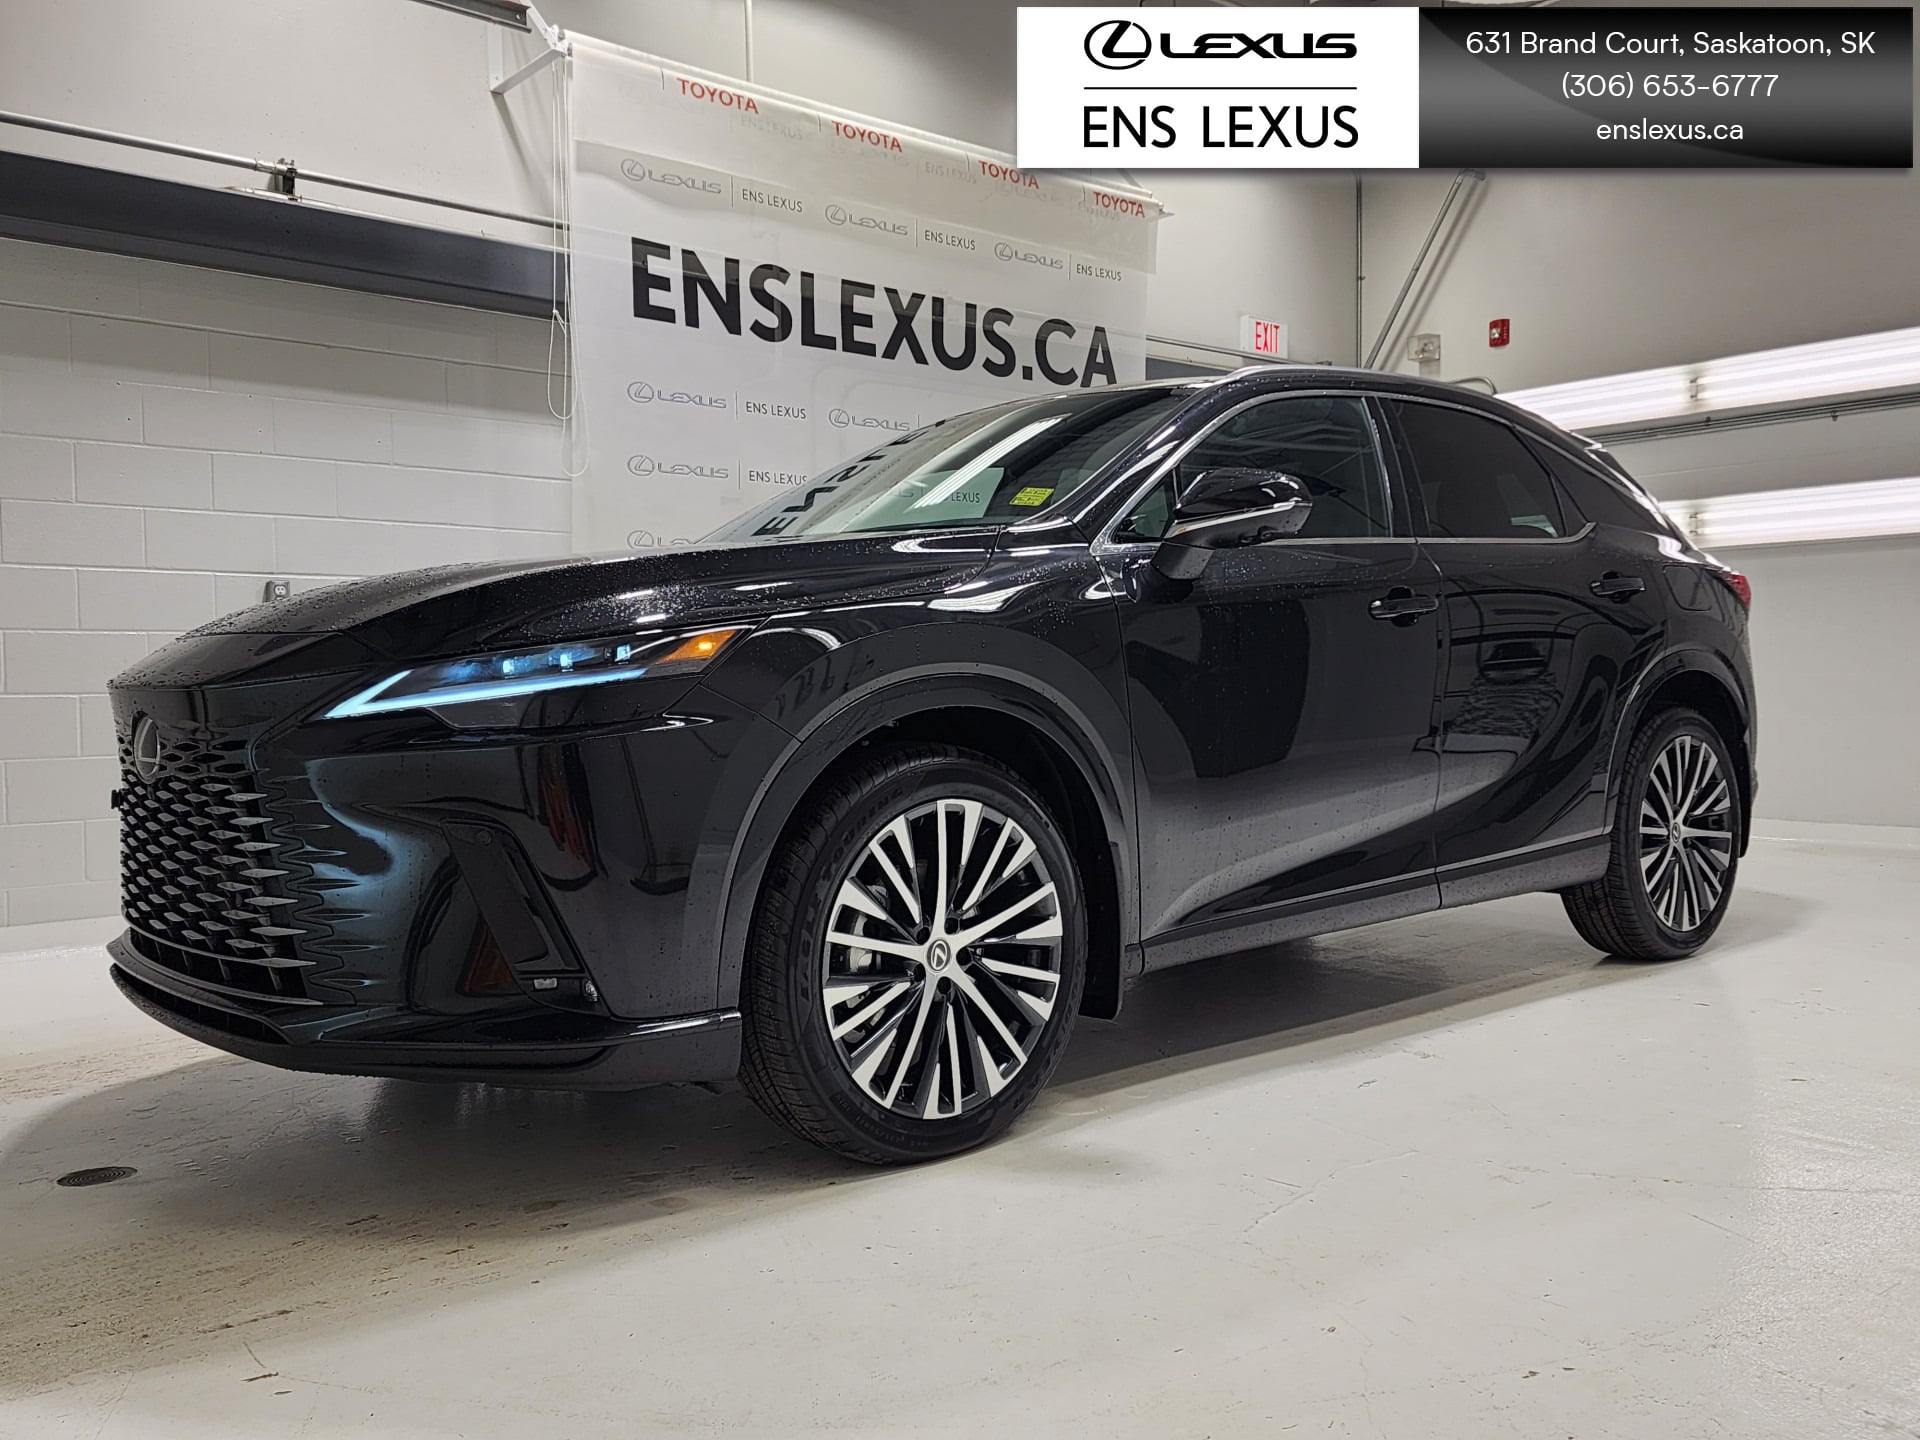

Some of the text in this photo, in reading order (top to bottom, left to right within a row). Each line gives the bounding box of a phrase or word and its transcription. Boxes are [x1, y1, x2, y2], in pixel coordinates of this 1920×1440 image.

[677, 77, 760, 115] TOYOTA
[831, 120, 903, 153] TOYOTA
[978, 160, 1040, 190] TOYOTA
[647, 168, 803, 213] LEXUS ENS LEXUS
[1093, 191, 1146, 218] TOYOTA
[848, 215, 976, 251] LEXUS ENS LEXUS
[1014, 252, 1122, 282] LEXUS ENS LEXUS
[631, 237, 1118, 388] ENSLEXUS.CA
[1255, 320, 1280, 354] EXIT
[657, 390, 807, 420] LEXUS ENS LEXUS
[852, 415, 910, 431] LEXUS
[657, 462, 729, 479] LEXUS
[749, 470, 771, 483] ENS
[951, 491, 981, 504] LEXUS
